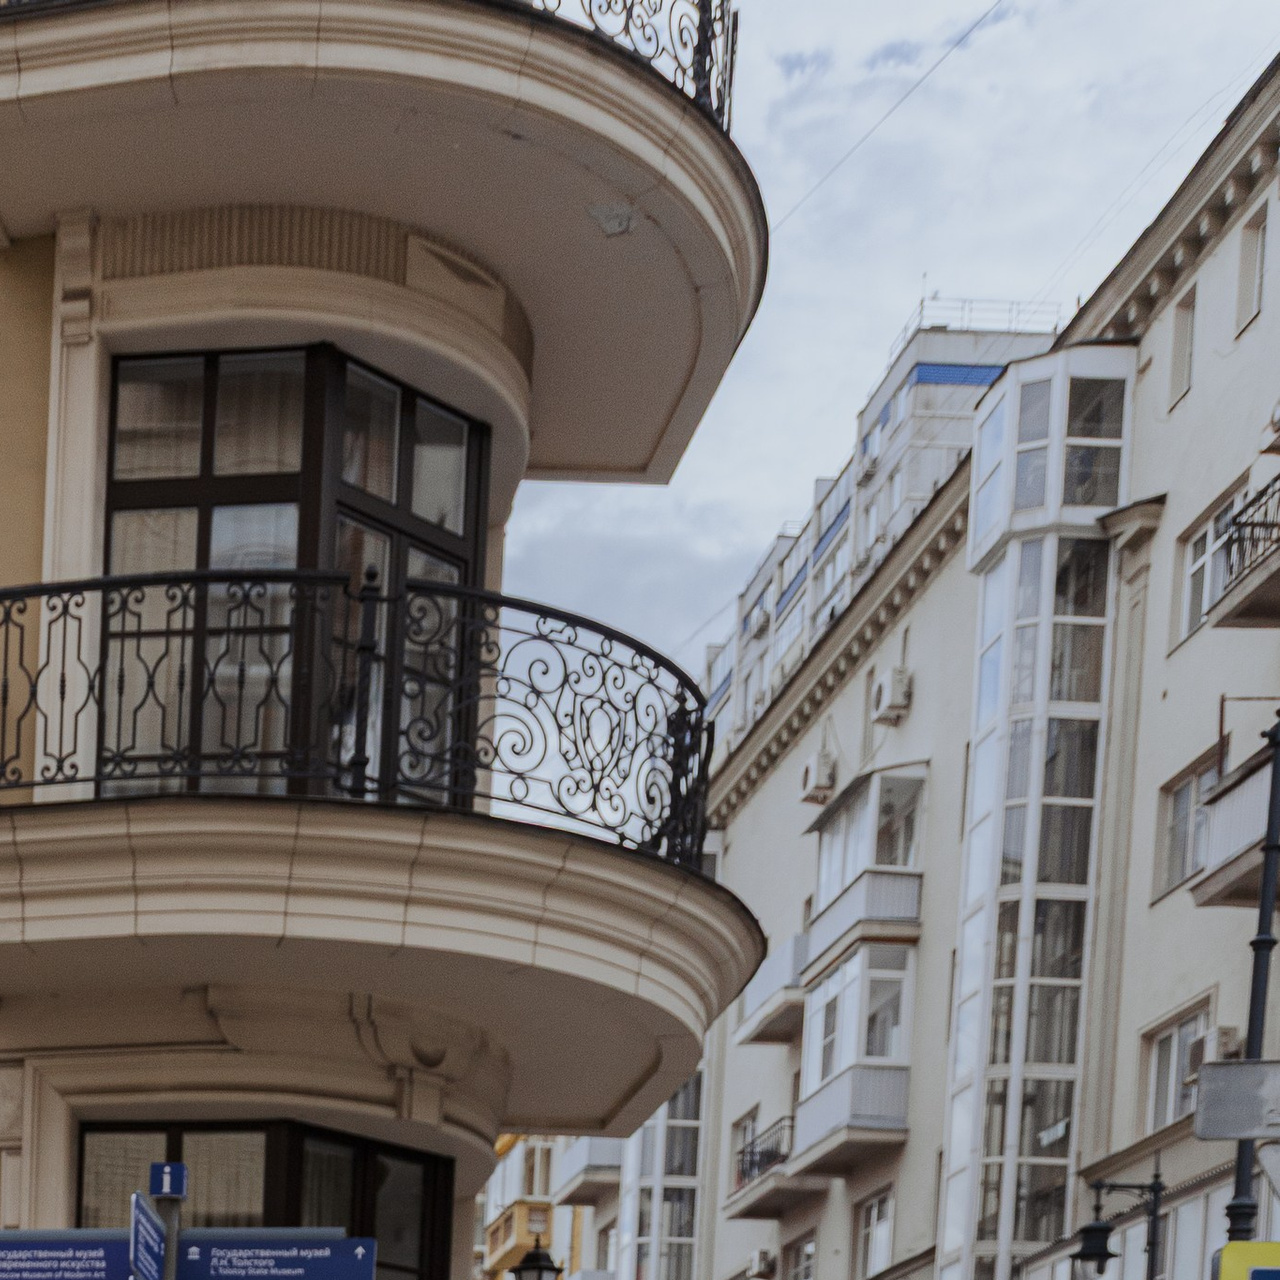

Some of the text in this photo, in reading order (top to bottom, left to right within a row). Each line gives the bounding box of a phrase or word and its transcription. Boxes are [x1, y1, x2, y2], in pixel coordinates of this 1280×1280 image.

[75, 1248, 104, 1260] музей
[211, 1247, 330, 1259] Государственный музей
[60, 1260, 106, 1270] искусства
[211, 1258, 275, 1267] Л.Н. Толстого
[22, 1271, 53, 1279] Museum
[54, 1270, 62, 1279] of
[63, 1271, 92, 1279] Modern
[94, 1271, 106, 1279] Art
[218, 1267, 246, 1276] Tolstoy
[248, 1267, 268, 1276] State
[270, 1268, 304, 1276] Museum
